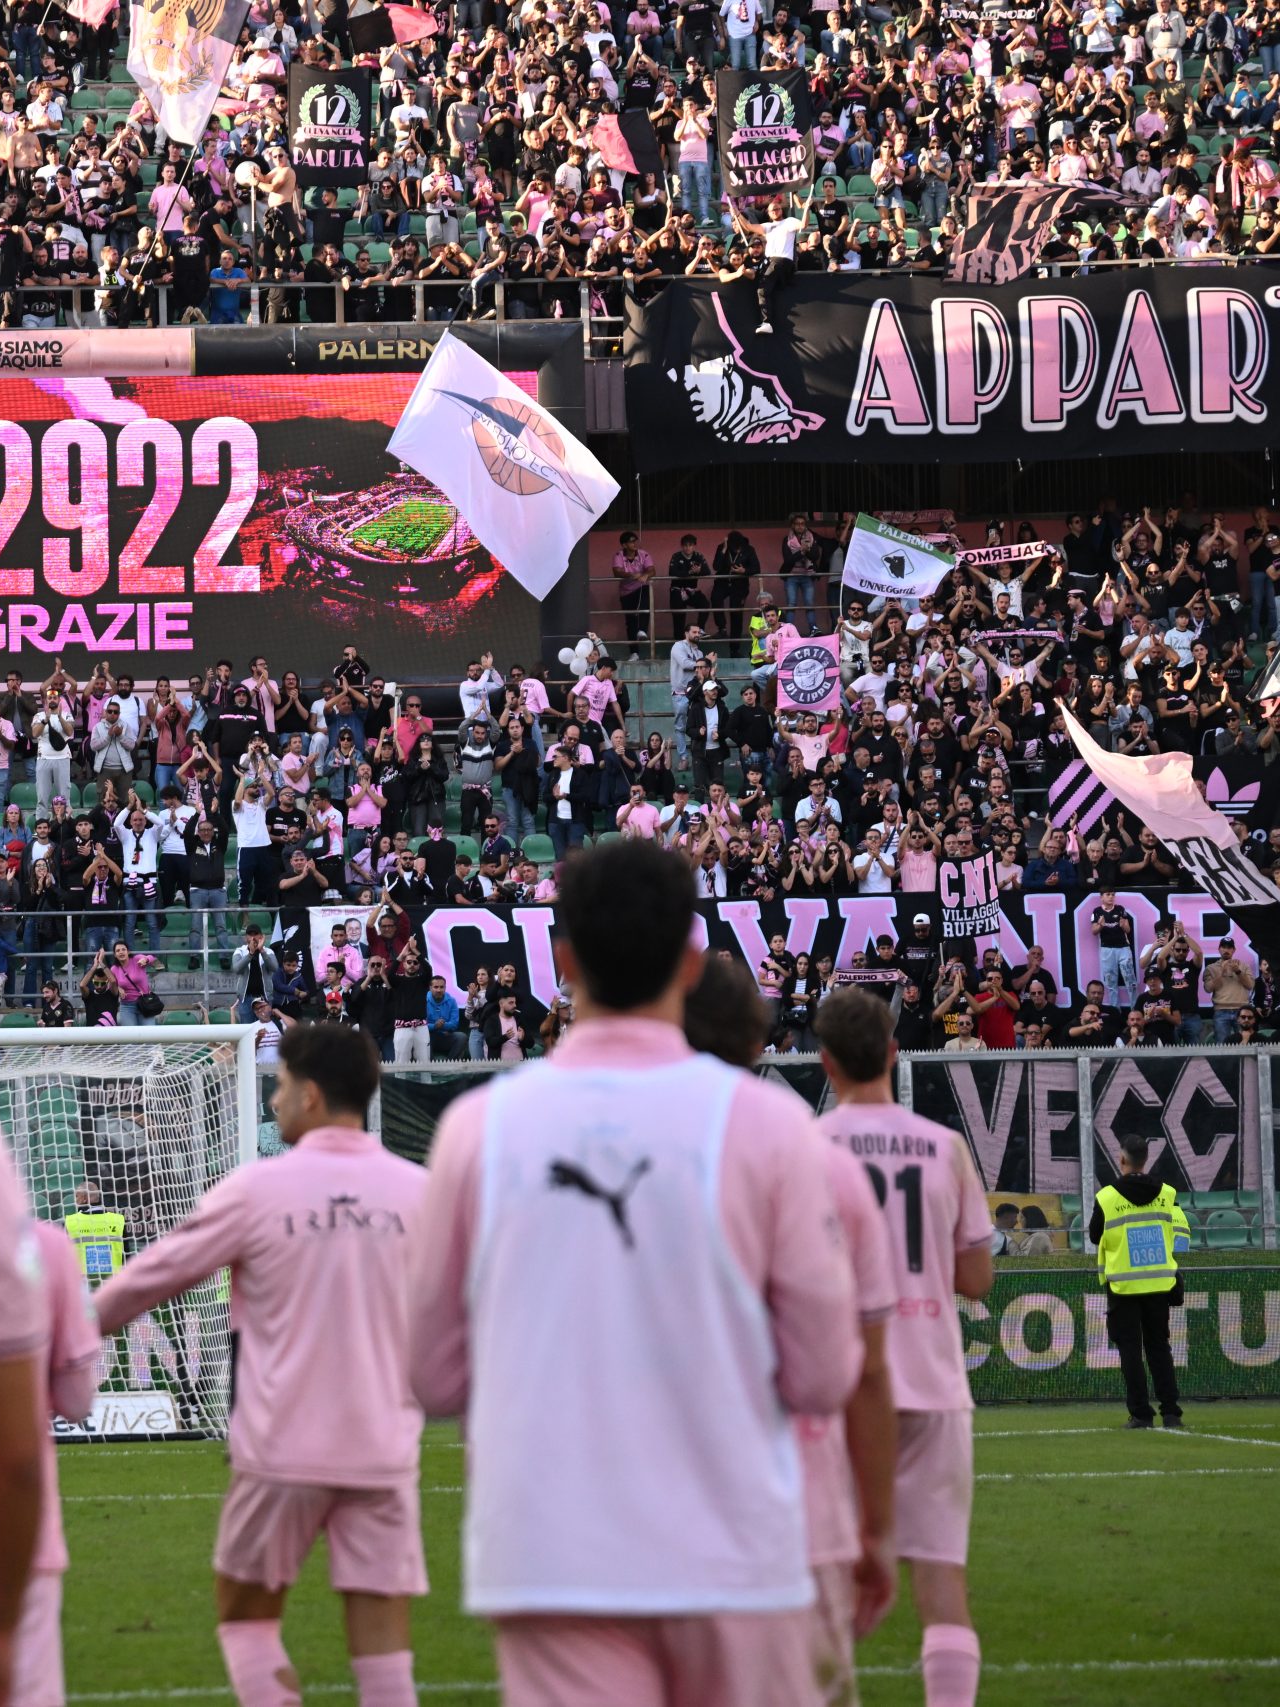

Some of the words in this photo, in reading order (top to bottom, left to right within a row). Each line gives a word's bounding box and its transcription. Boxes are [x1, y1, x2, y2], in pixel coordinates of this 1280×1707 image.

[314, 95, 347, 126] 12
[750, 94, 781, 127] 12
[293, 147, 365, 168] PARUTA
[727, 144, 807, 167] VILLAGGIO
[730, 171, 743, 186] S.
[745, 164, 809, 186] ROSALIA
[52, 243, 70, 260] 12
[319, 339, 437, 360] PALER
[846, 287, 1280, 437] APPAR
[877, 523, 934, 551] PALERMO
[794, 648, 825, 660] CATI
[786, 682, 798, 696] DI
[799, 681, 831, 702] LIPPO
[940, 850, 999, 908] CNI
[942, 899, 1000, 922] VILLAGGIO
[943, 914, 1000, 938] RUFFIN
[972, 892, 1260, 1008] NOR
[838, 973, 878, 982] PALERMO
[850, 1134, 937, 1159] DOUARON
[1128, 1228, 1163, 1245] STEWARD
